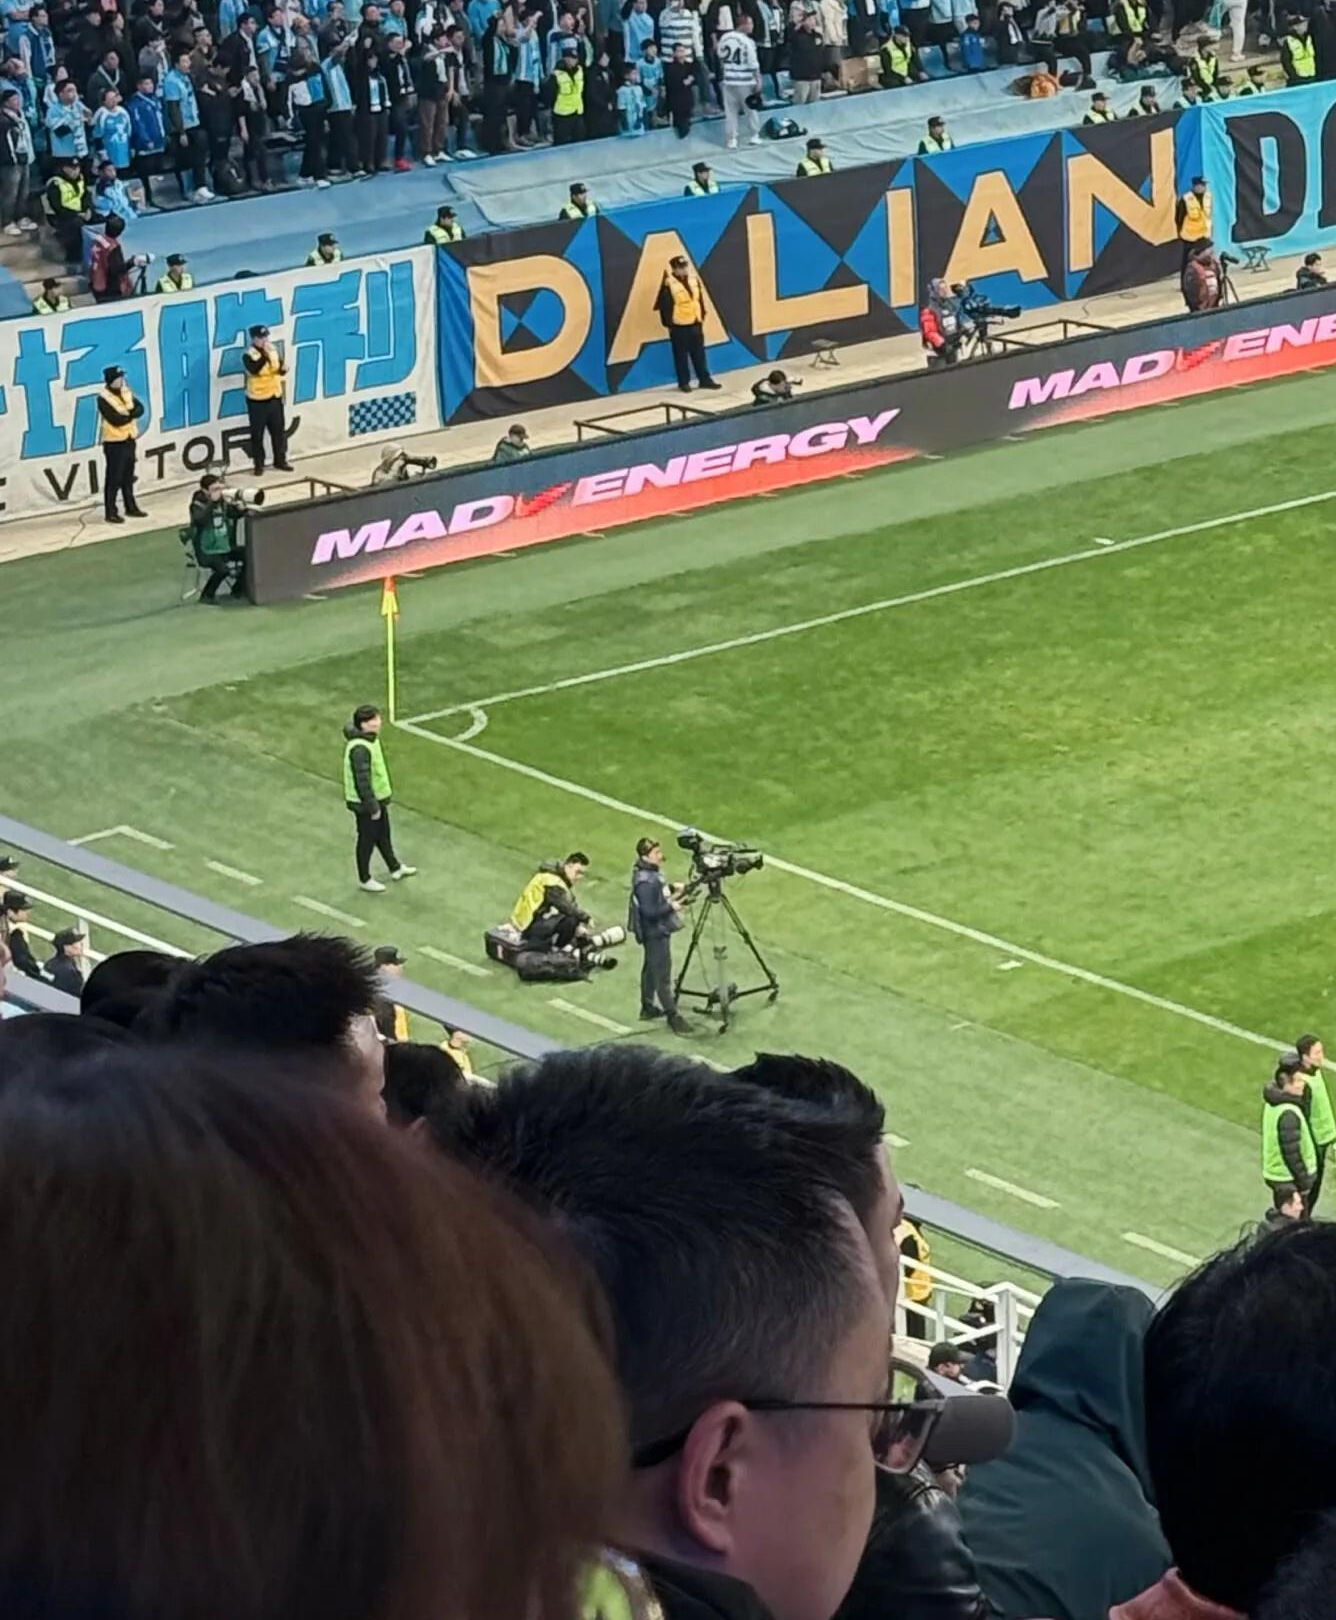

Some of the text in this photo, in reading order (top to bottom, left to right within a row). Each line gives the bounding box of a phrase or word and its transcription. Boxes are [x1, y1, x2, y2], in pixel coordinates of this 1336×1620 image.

[468, 128, 1180, 389] DALIAN
[0, 260, 417, 460] 场胜利
[1008, 352, 1176, 410] MAD
[310, 408, 901, 566] MAD ENERGY
